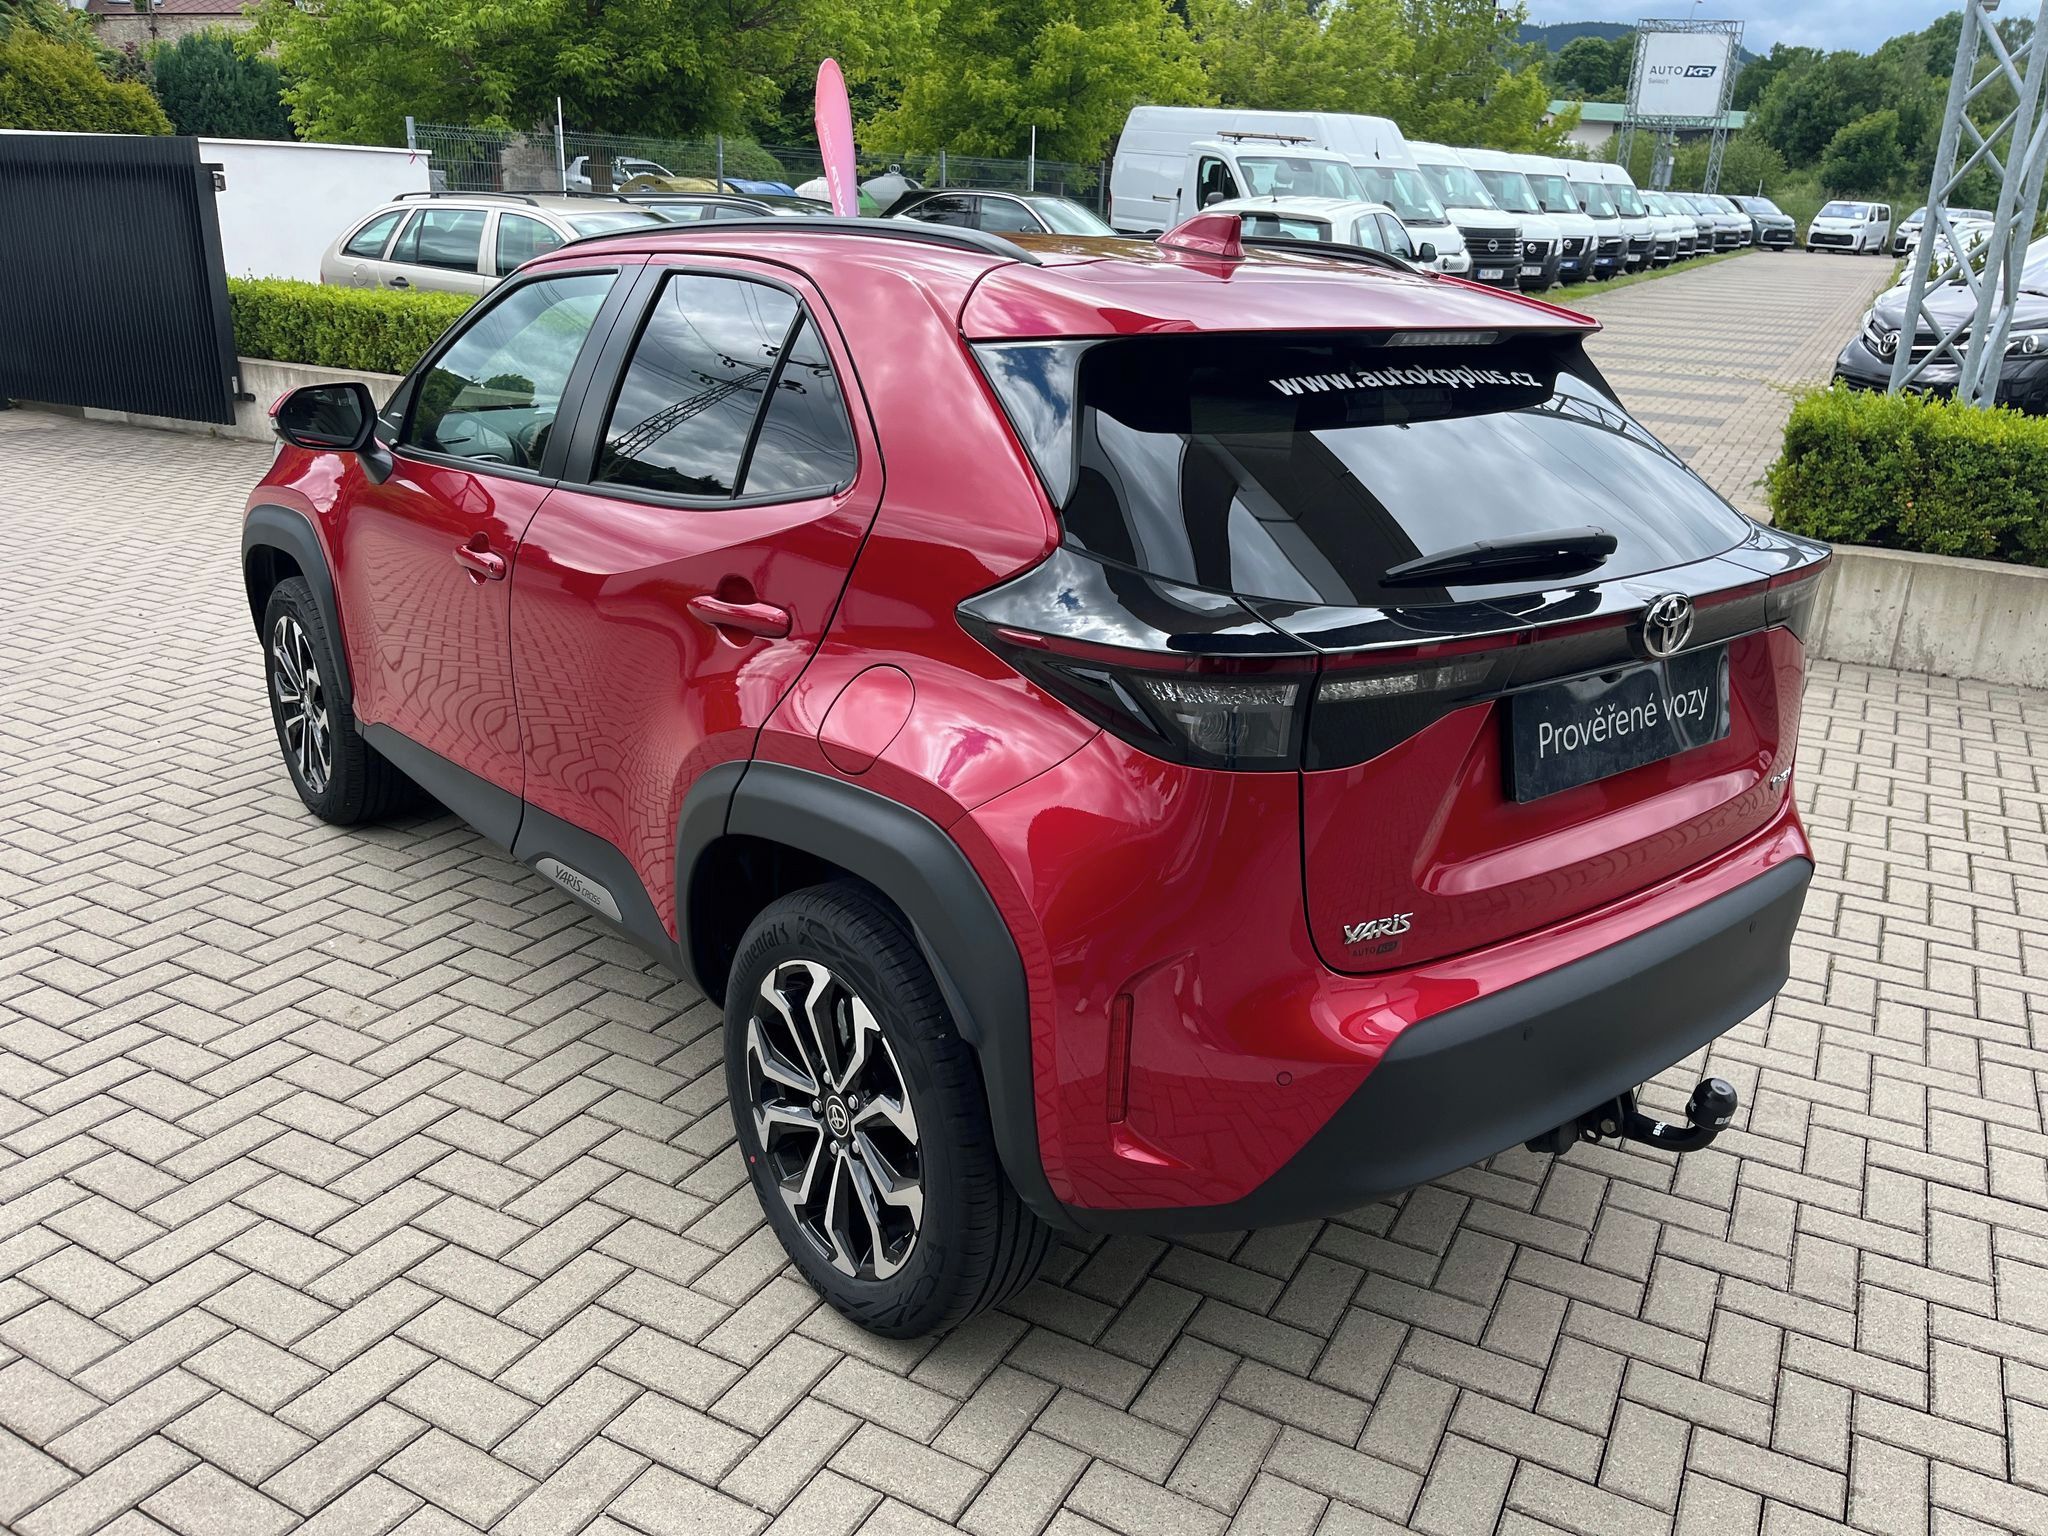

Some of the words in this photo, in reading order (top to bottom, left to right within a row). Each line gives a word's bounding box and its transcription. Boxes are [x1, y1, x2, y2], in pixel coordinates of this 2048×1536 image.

[1650, 65, 1683, 75] AUTO
[1268, 363, 1543, 396] www.autokpplus.cz
[1538, 693, 1658, 759] Prověřené
[1662, 686, 1709, 721] vozy
[582, 888, 601, 905] CROSS
[1352, 946, 1376, 957] AUTO
